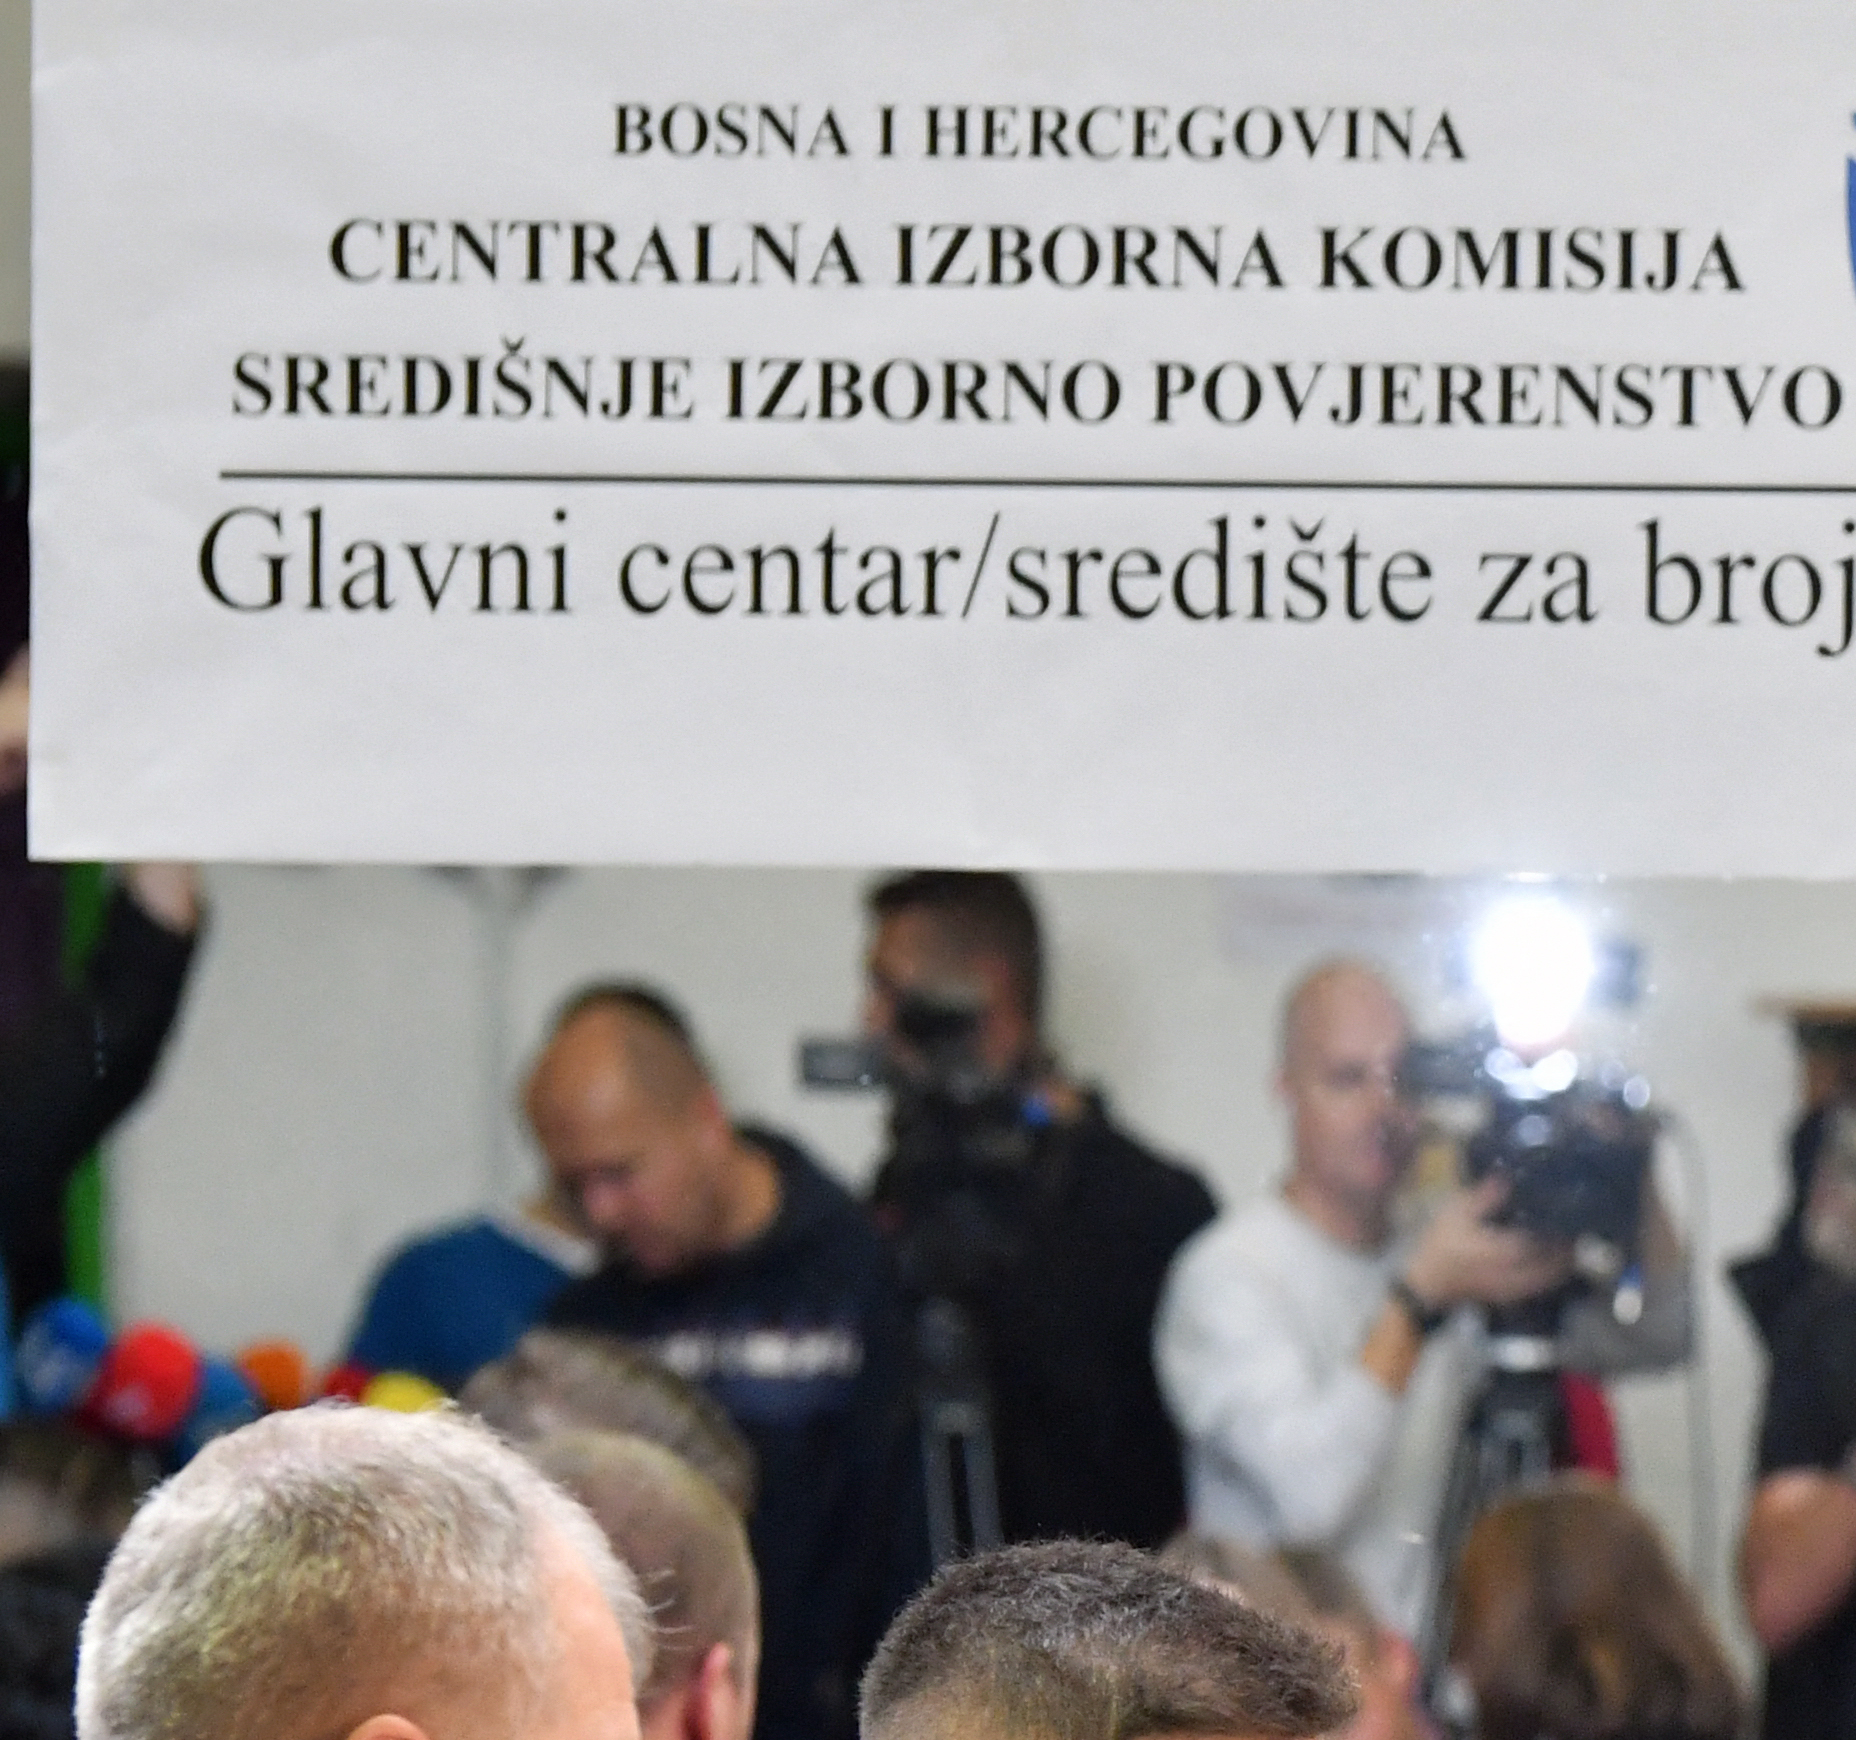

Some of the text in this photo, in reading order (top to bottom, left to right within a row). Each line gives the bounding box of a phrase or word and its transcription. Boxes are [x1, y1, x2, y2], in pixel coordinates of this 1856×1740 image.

[613, 103, 1467, 162] BOSNA I HERCEGOVINA
[328, 219, 1746, 292] CENTRALNA IZBORNA KOMISIJA
[231, 337, 1845, 429] SREDIŠNJE IZBORNO POVJERENSTVO
[196, 504, 571, 614] Glavni
[617, 512, 1435, 627] centar/središte
[1475, 550, 1600, 626] za
